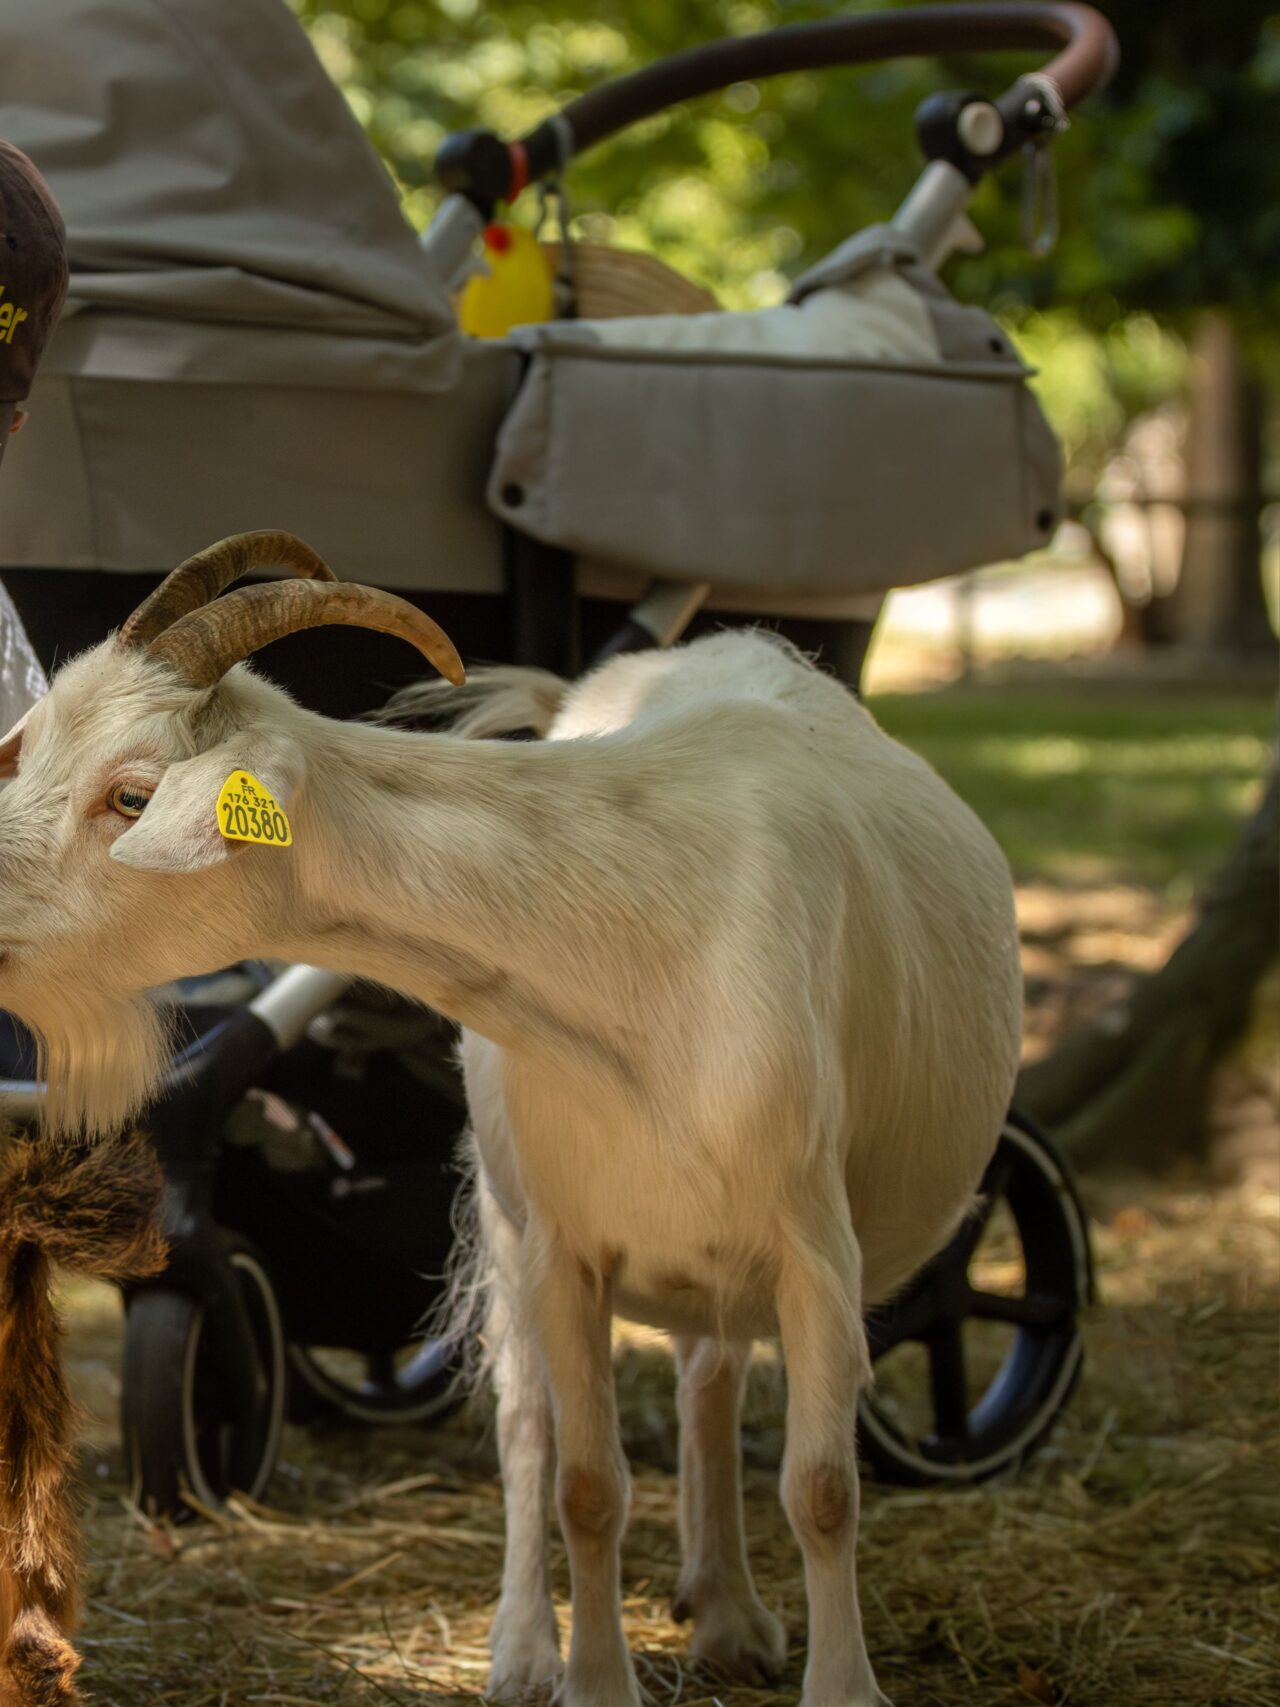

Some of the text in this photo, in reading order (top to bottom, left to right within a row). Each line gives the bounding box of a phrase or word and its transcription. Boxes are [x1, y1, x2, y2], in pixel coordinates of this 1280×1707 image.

[241, 785, 256, 796] FR
[227, 793, 276, 810] 176 321
[223, 803, 287, 842] 20380
